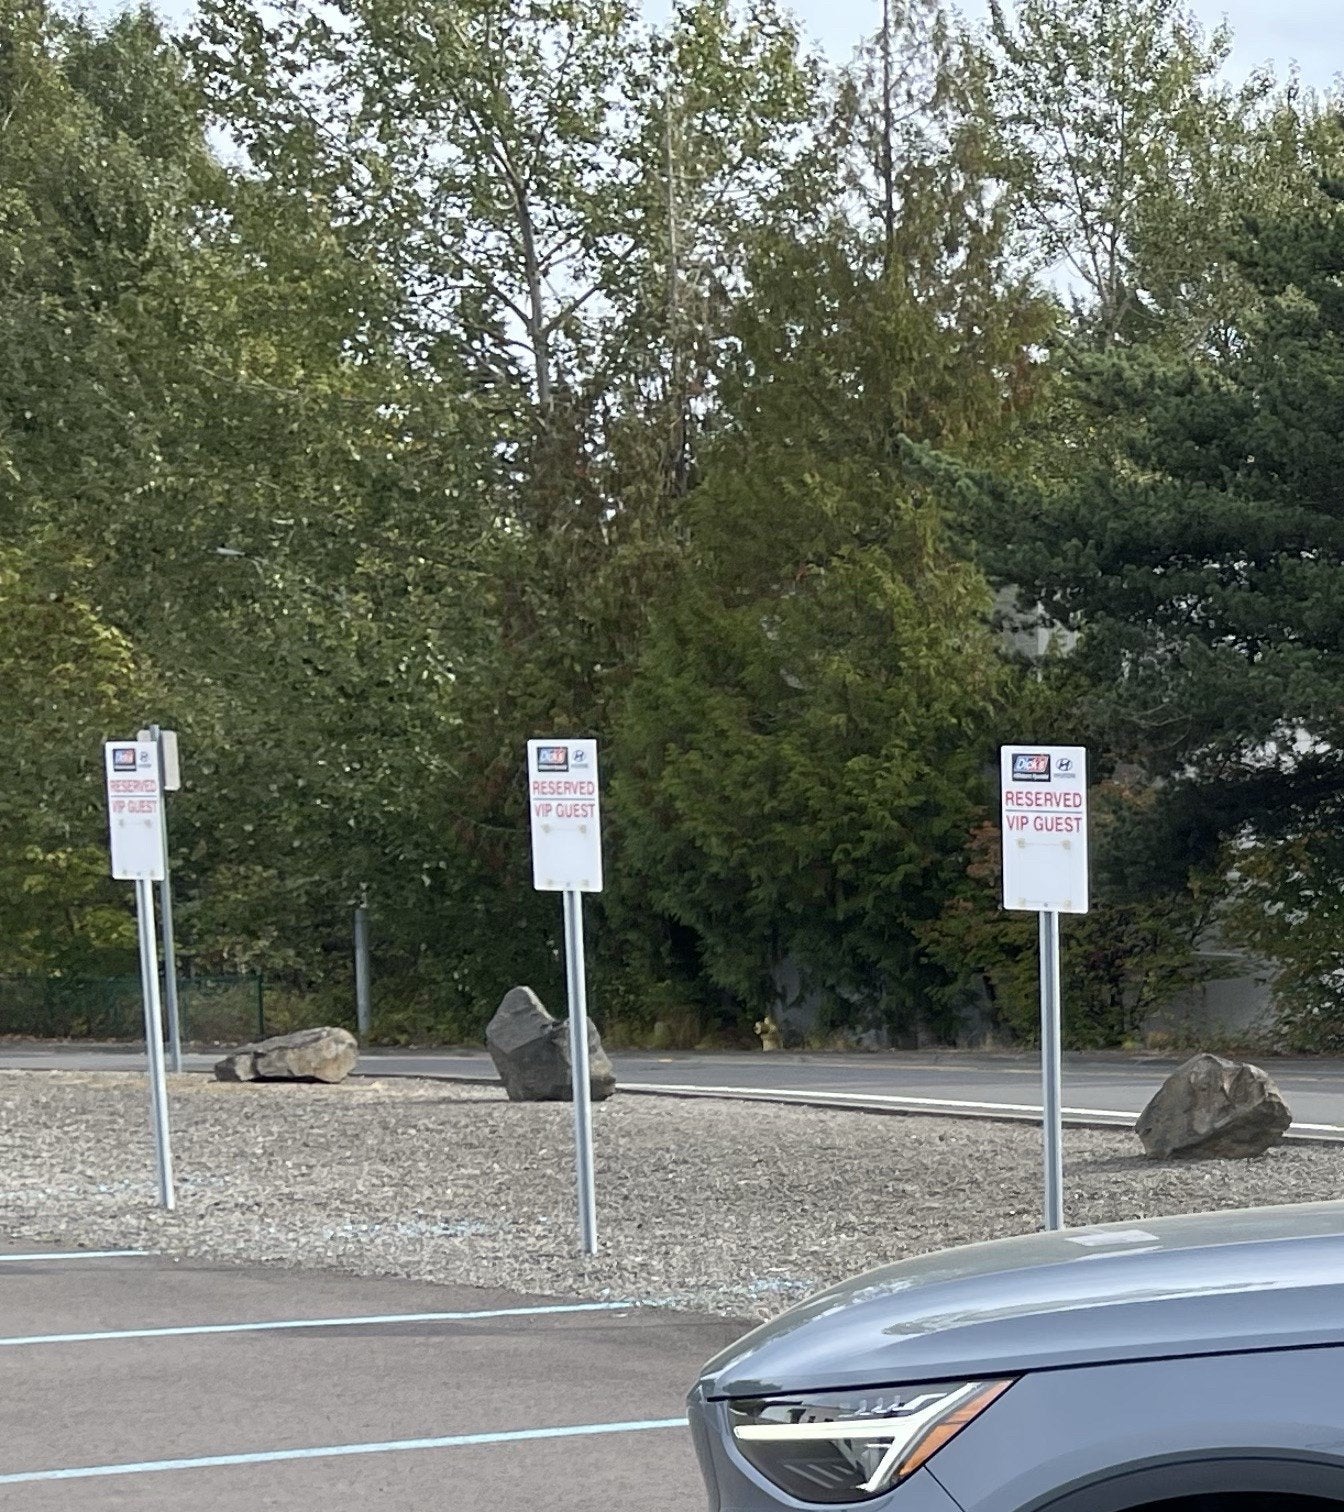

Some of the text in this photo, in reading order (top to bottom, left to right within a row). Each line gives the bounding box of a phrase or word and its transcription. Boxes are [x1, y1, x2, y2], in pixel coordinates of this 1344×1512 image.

[532, 780, 595, 795] RESERVED
[1005, 791, 1082, 808] RESERVED
[534, 803, 595, 818] VIP GUEST
[1006, 816, 1083, 833] VIP GUEST
